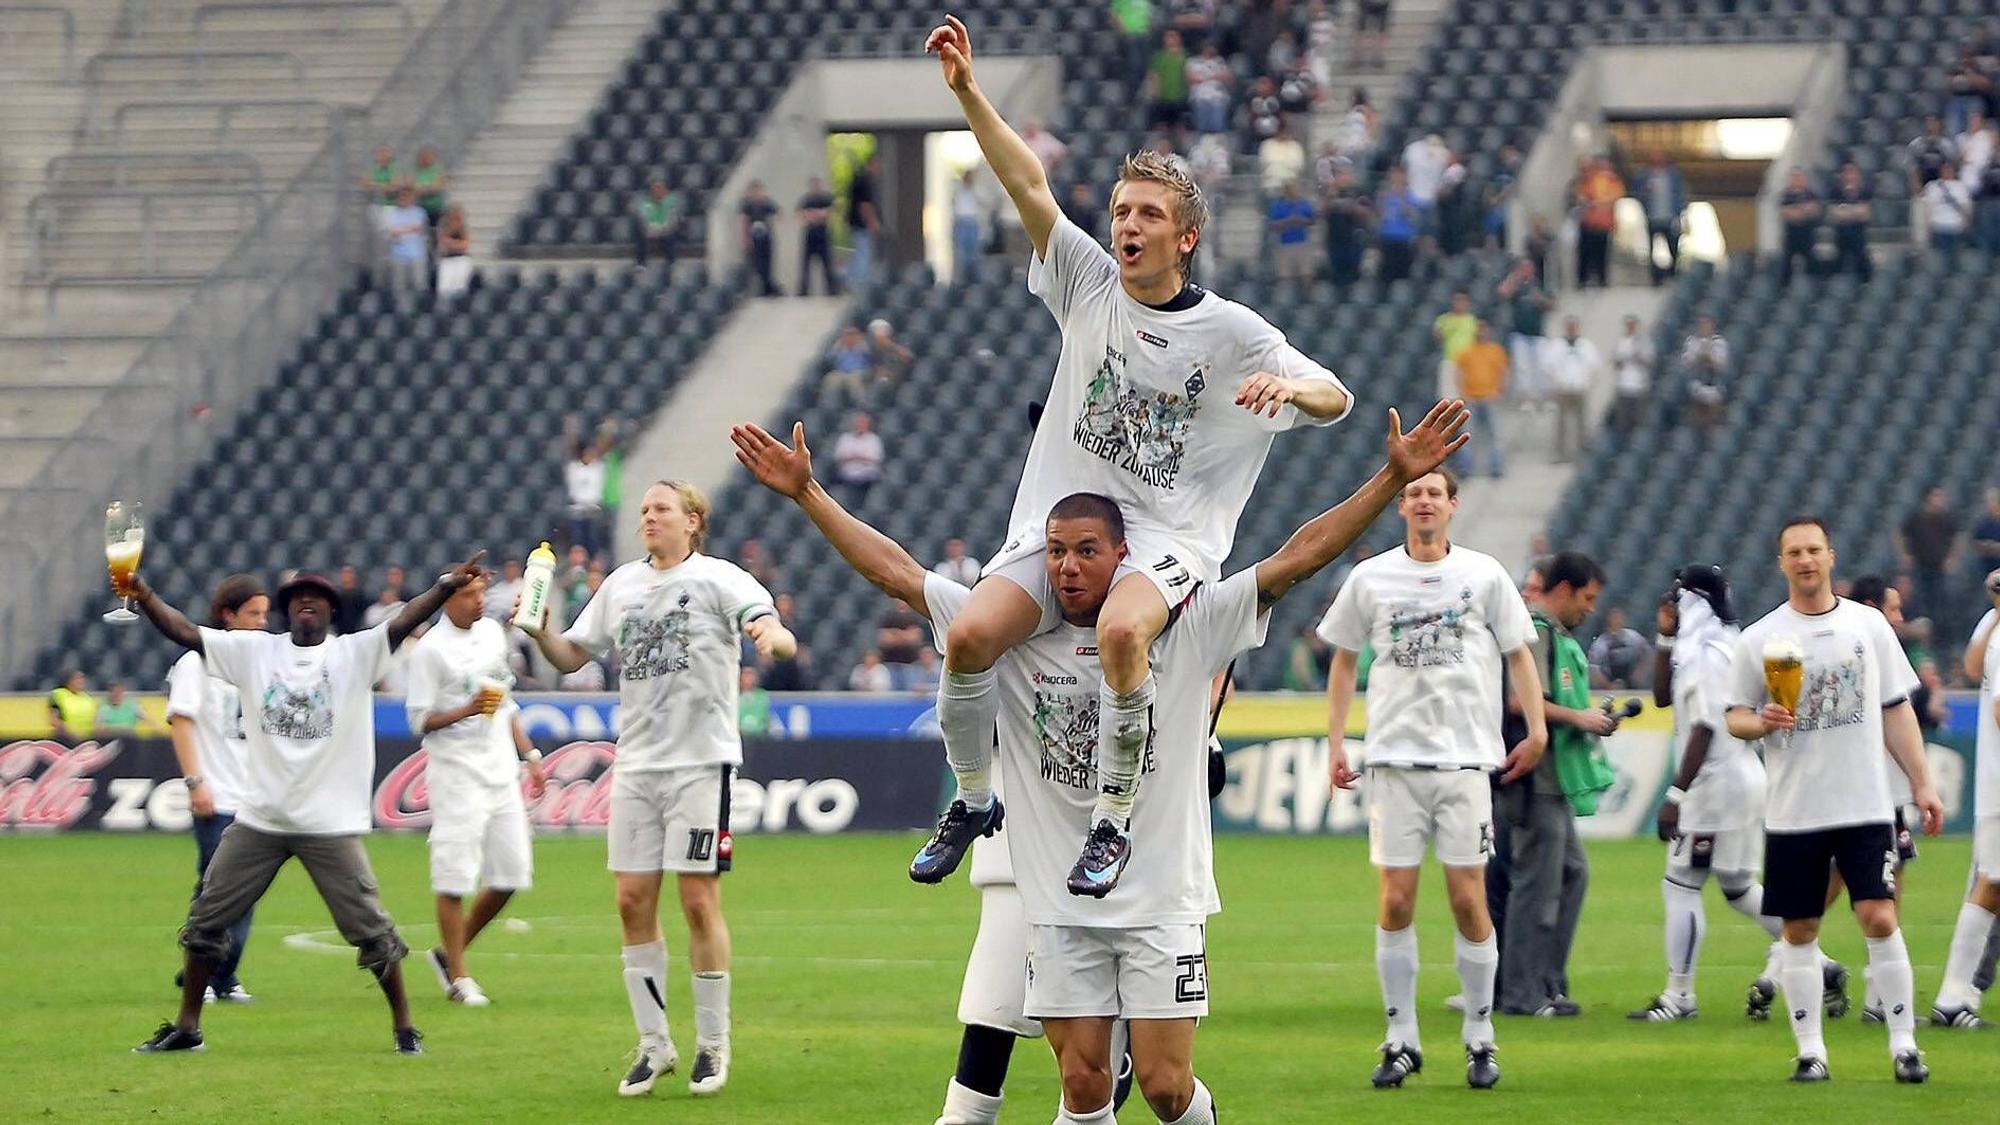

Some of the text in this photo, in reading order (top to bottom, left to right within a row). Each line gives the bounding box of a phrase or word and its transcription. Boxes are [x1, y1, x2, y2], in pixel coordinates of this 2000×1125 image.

[1073, 421, 1121, 464] WIEDER
[1041, 754, 1090, 791] WIEDER
[1222, 737, 1368, 832] JEVE
[101, 777, 194, 831] ze
[731, 778, 861, 834] ero
[686, 827, 714, 860] 10
[1175, 953, 1206, 1003] 23
